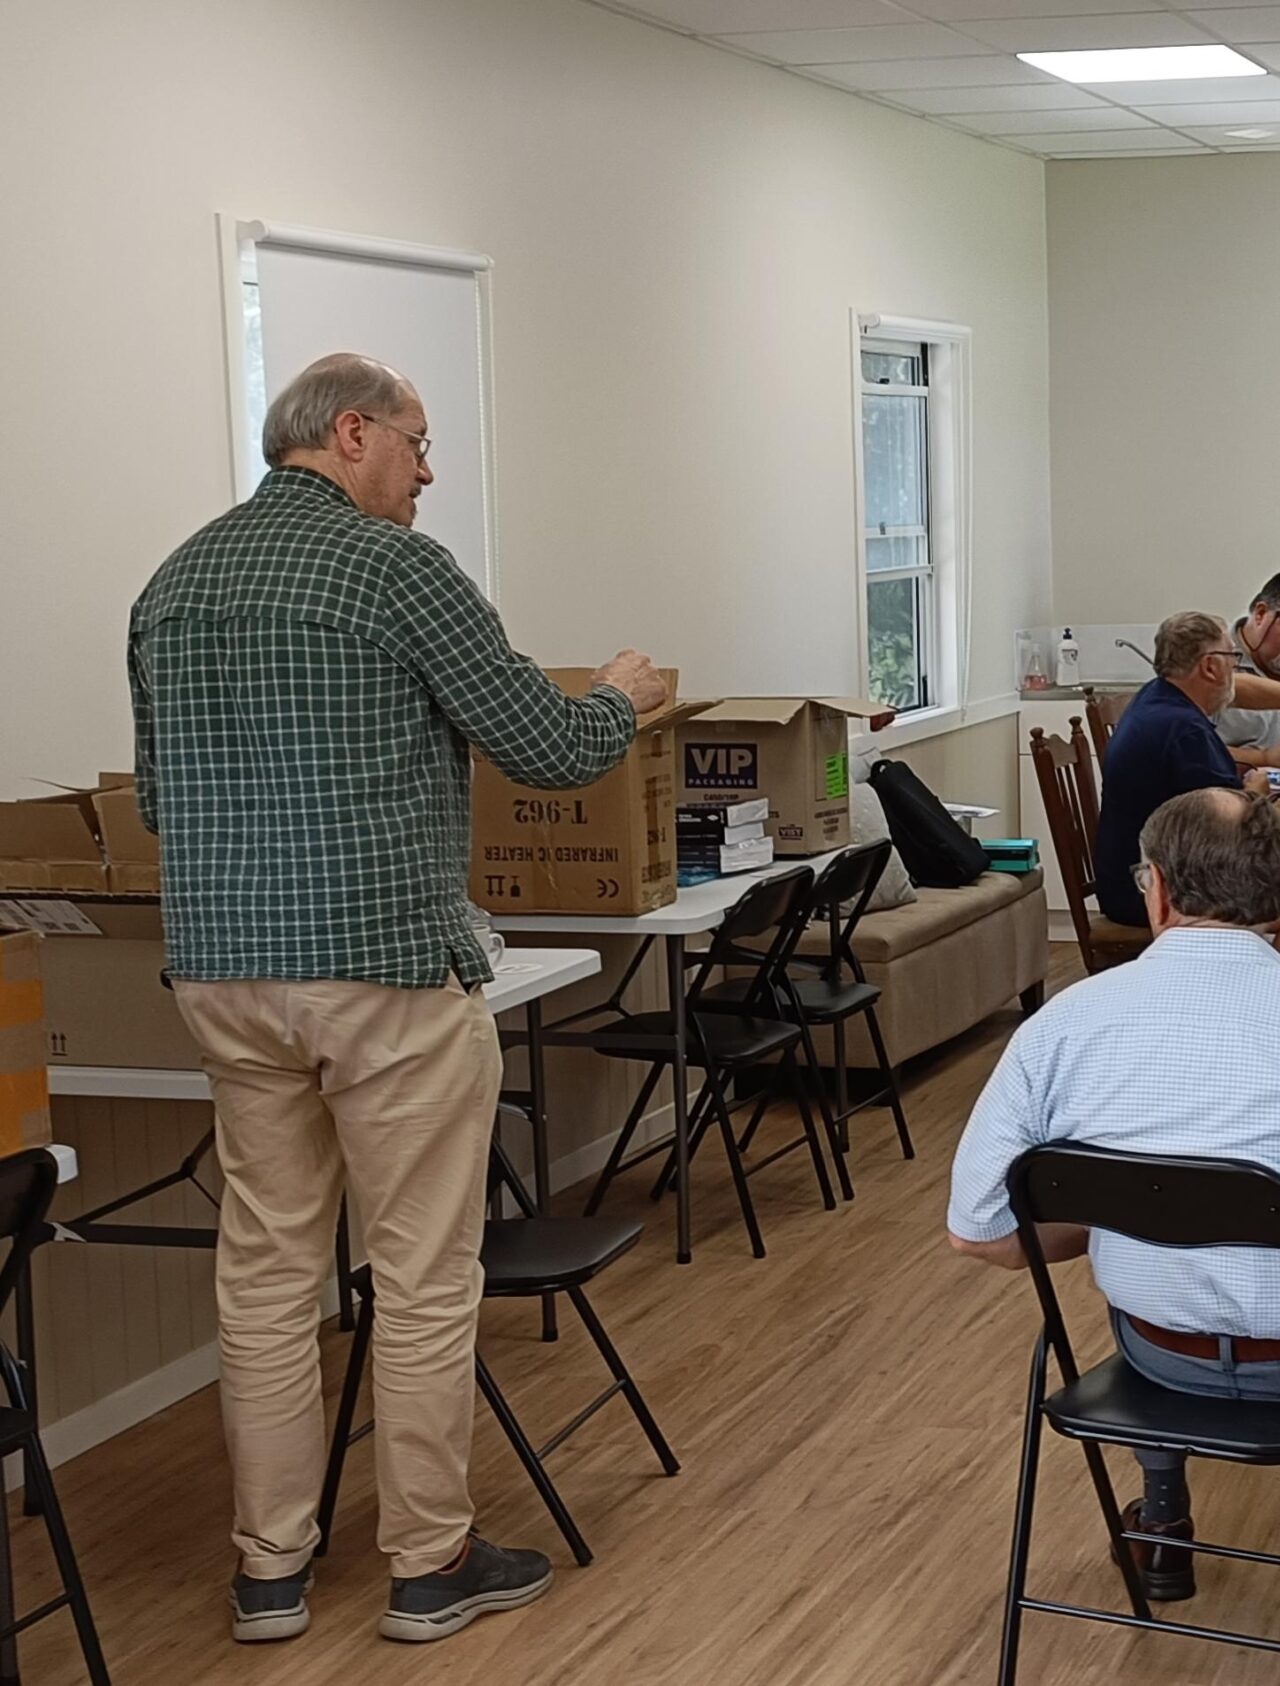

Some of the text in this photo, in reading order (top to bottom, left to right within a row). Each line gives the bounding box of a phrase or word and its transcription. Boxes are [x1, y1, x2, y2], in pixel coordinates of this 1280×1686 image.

[690, 748, 754, 775] VIP
[688, 778, 754, 787] PACKAGING
[513, 799, 588, 824] T-962
[484, 846, 534, 862] HEATER
[555, 847, 619, 862] INFRARED
